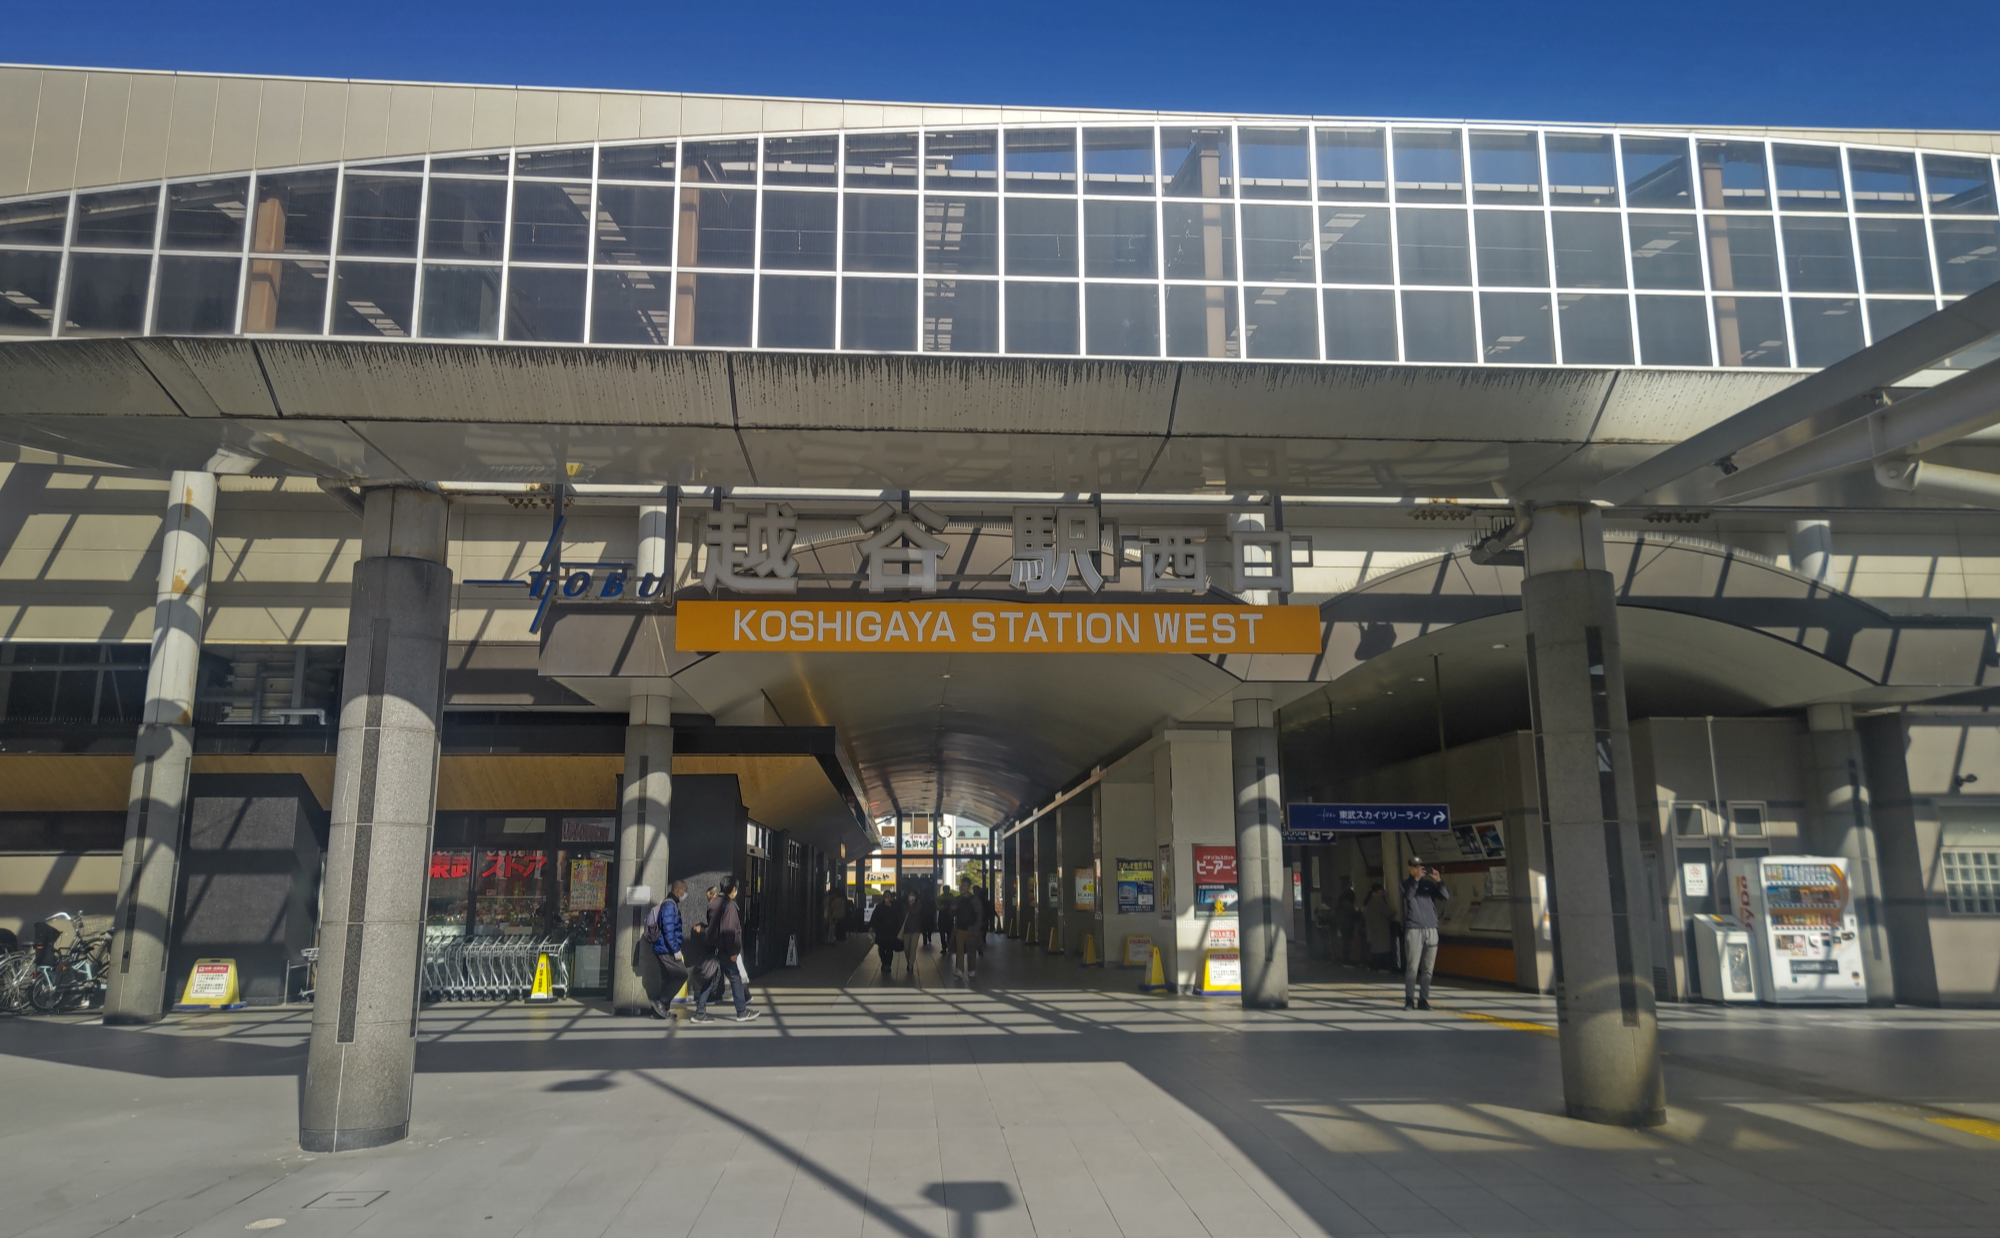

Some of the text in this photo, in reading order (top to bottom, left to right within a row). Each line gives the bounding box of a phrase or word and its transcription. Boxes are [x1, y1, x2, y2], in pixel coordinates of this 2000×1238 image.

[702, 502, 1294, 595] 越谷駅西口
[734, 609, 1263, 644] KOSHIGAYA STATION WEST
[1339, 810, 1431, 820] 東武スカイツリーライン
